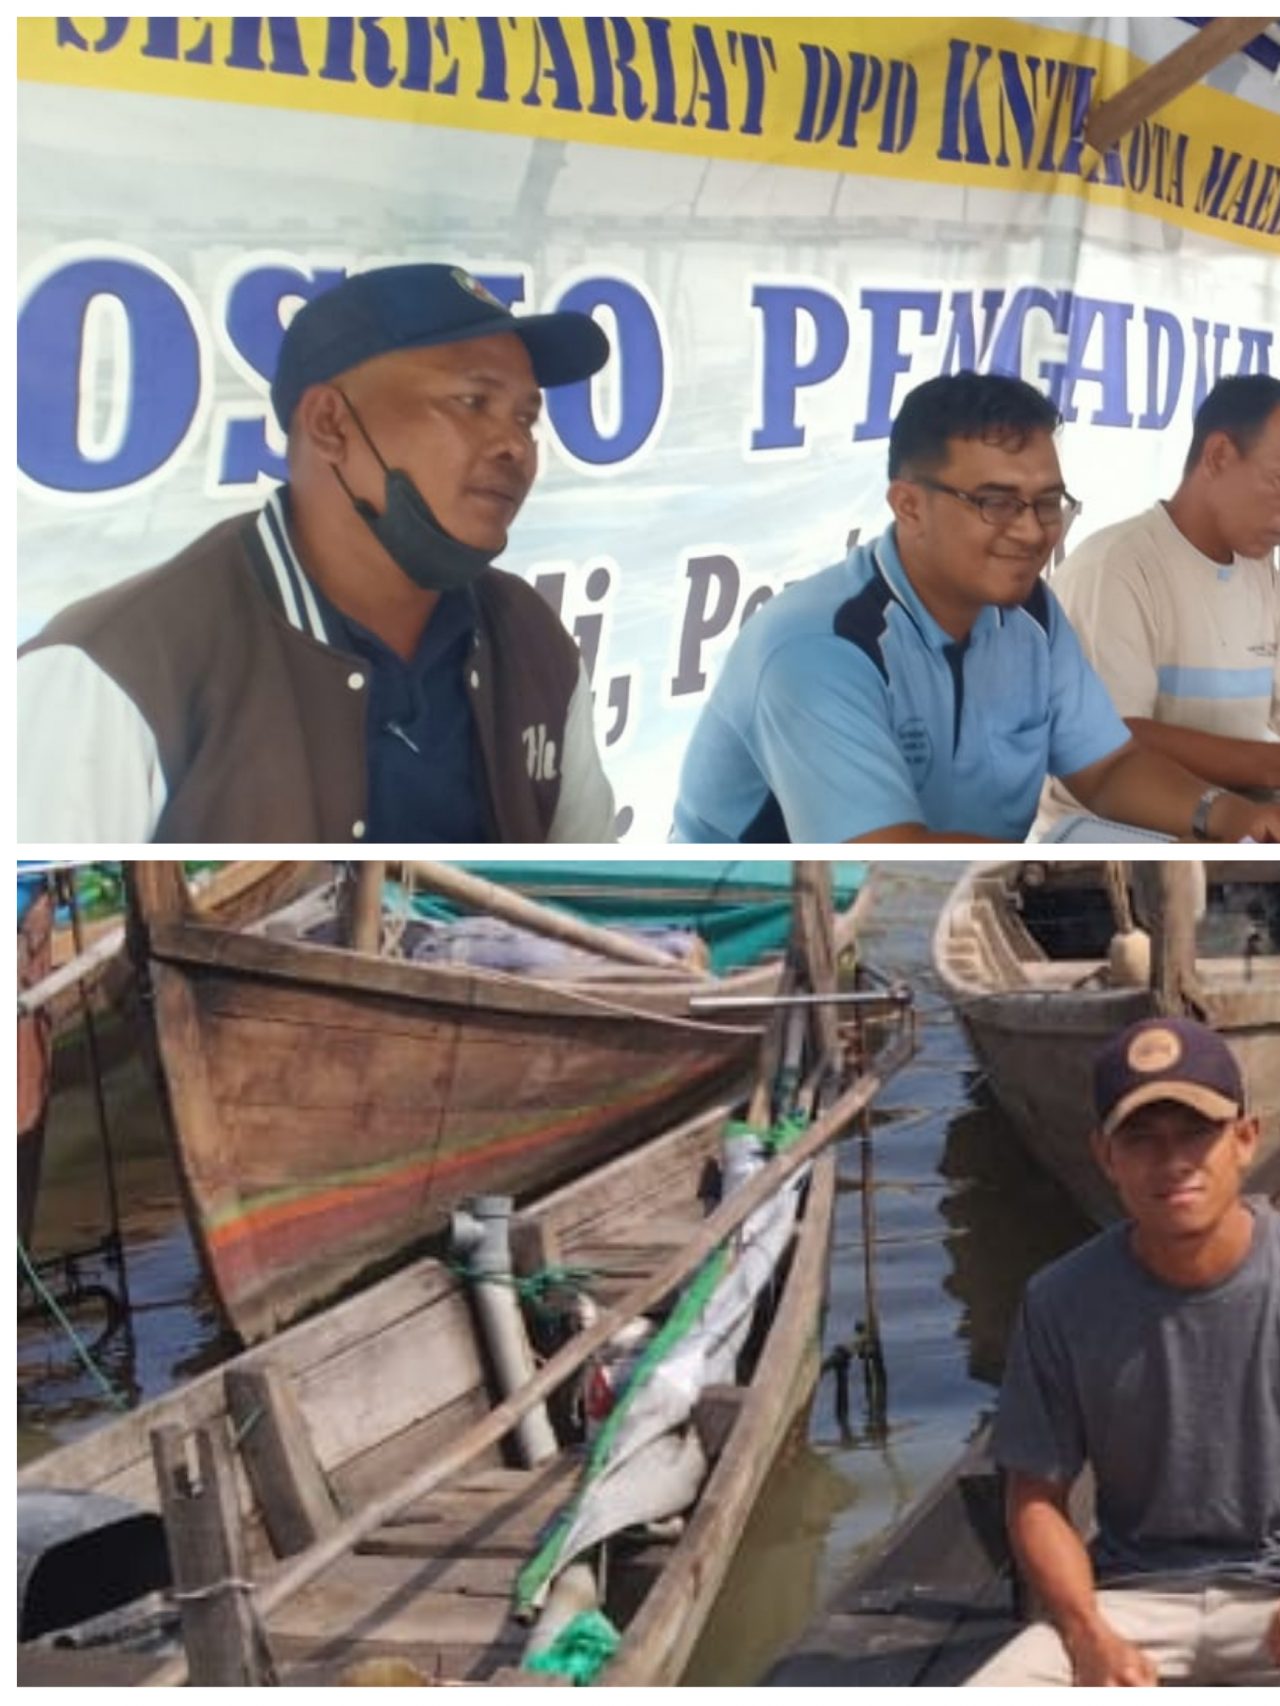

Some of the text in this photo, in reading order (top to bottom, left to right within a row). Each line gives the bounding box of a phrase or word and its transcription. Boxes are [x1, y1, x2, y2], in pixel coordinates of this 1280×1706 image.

[55, 17, 777, 134] KRETARIAT
[794, 42, 918, 153] DPD
[17, 256, 664, 493] OSO
